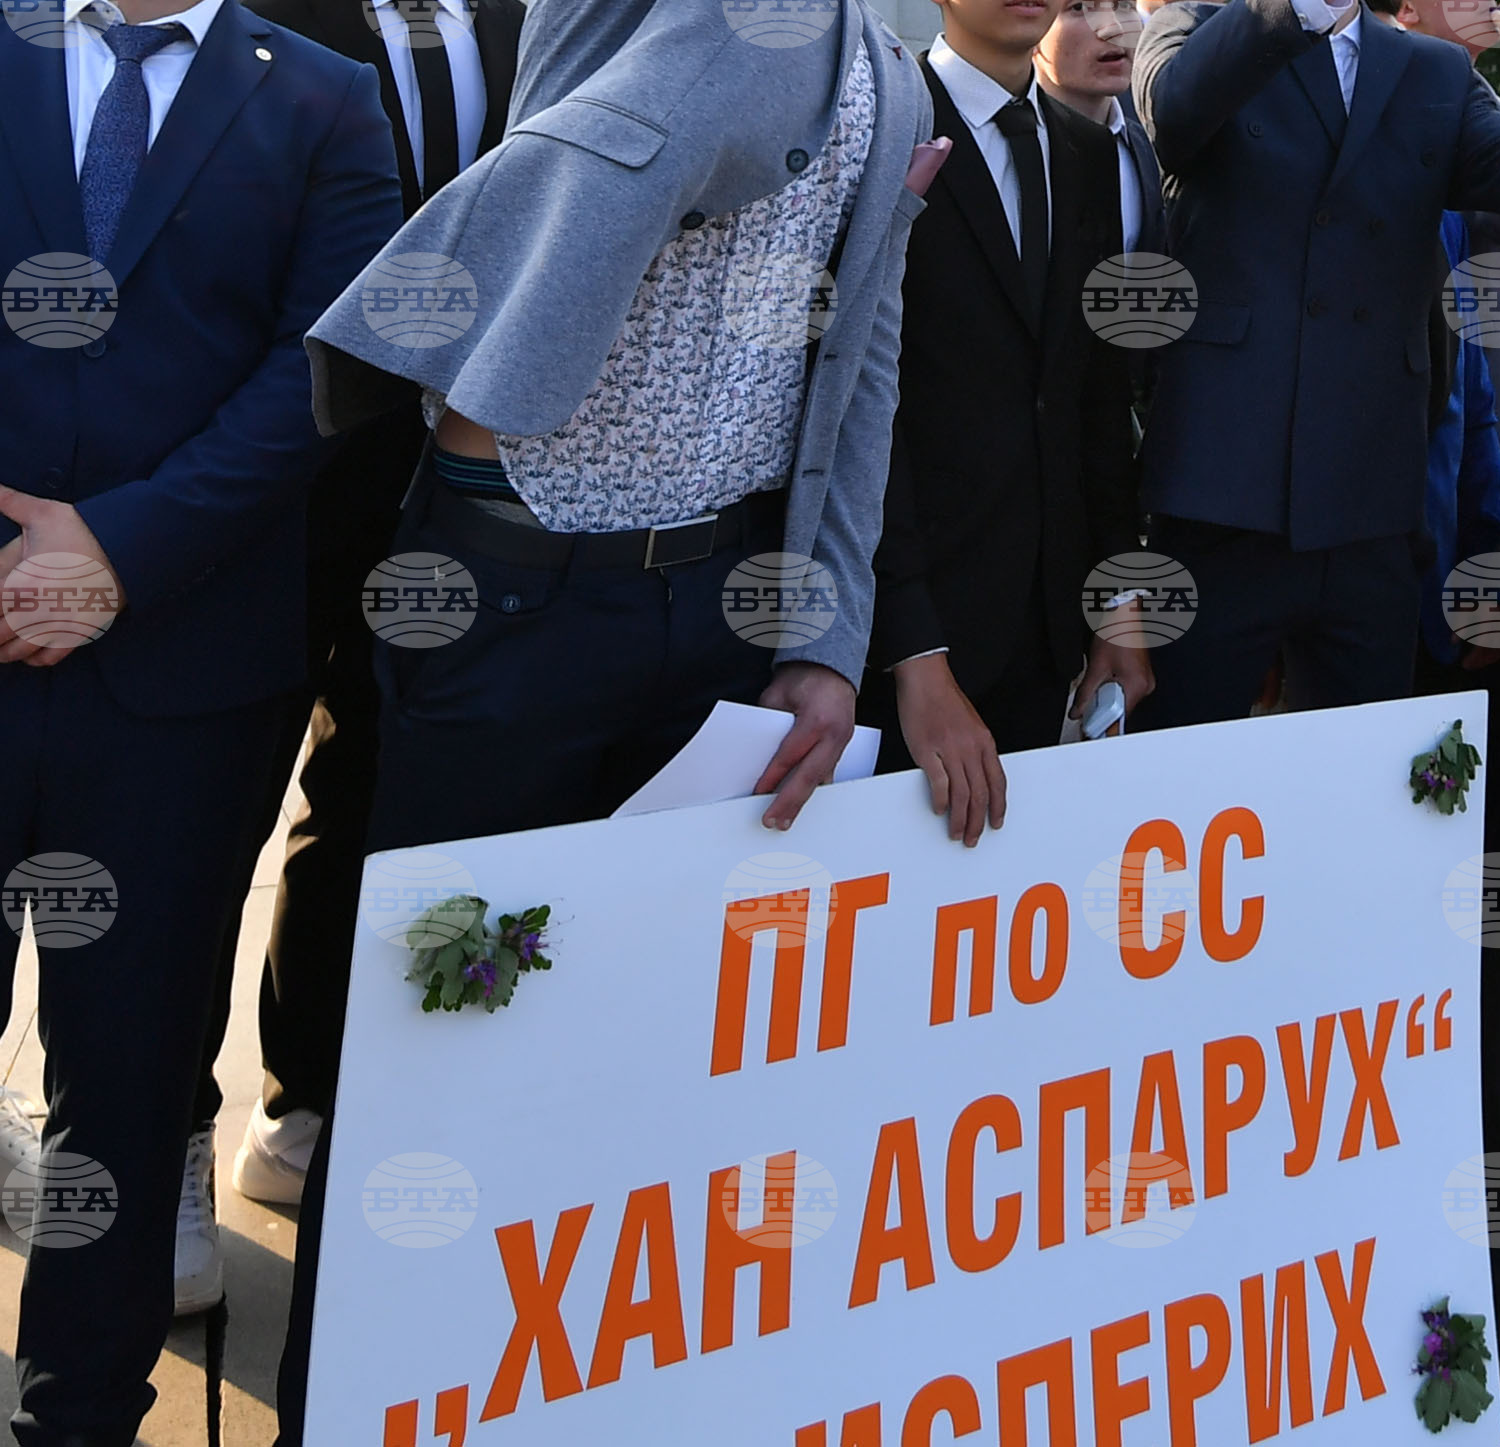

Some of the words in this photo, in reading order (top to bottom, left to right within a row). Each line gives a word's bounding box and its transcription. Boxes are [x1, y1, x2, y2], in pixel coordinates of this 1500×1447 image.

[711, 873, 890, 1076] ПГ
[930, 882, 1069, 1025] по
[1119, 807, 1265, 980] СС
